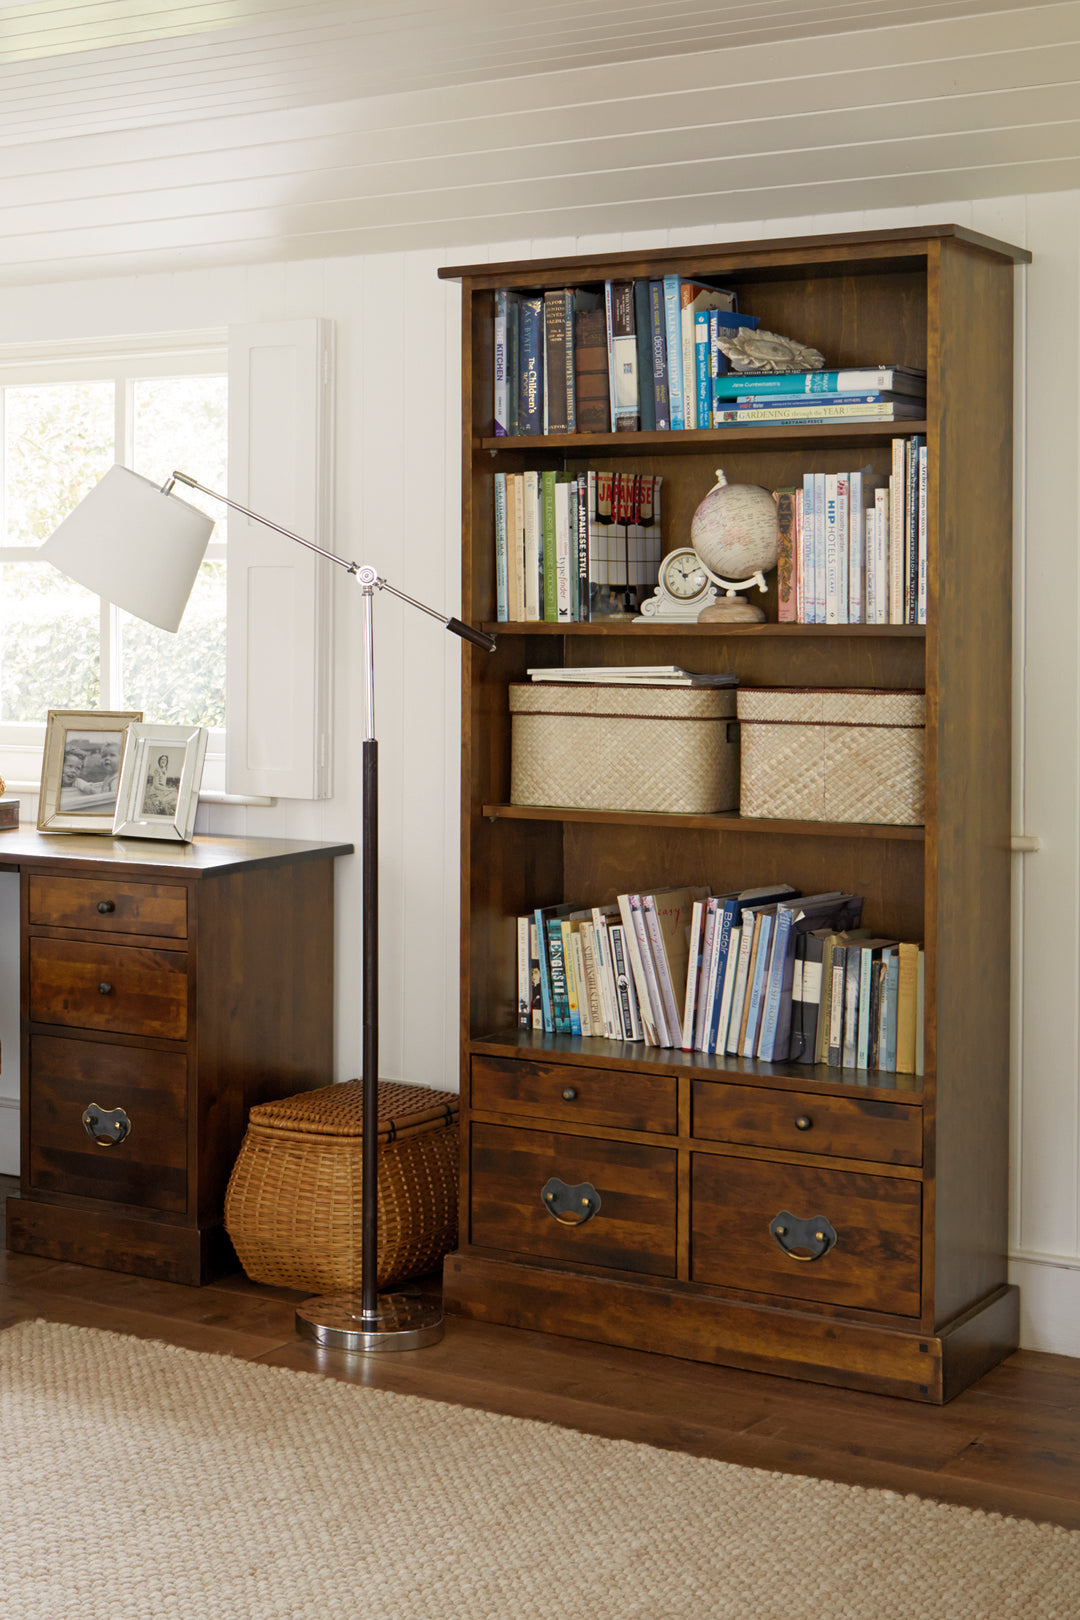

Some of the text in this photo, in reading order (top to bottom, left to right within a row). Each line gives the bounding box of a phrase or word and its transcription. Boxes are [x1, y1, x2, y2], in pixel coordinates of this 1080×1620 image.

[523, 327, 531, 354] BYATT
[653, 336, 666, 378] decorating
[528, 357, 537, 414] The Children's
[739, 410, 791, 420] GARDENING
[823, 405, 845, 416] YEAR
[599, 483, 652, 504] JAPANESE
[610, 503, 642, 524] STYLE
[804, 499, 813, 532] relaxed
[827, 500, 836, 525] HIP
[579, 504, 588, 578] JAPANESE STYLE
[804, 534, 813, 562] home
[827, 526, 836, 565] HOTELS
[657, 908, 682, 935] easy
[720, 911, 733, 954] Boudoir
[740, 934, 752, 955] junk
[770, 960, 783, 1001] SWEDISH
[766, 1004, 778, 1034] ROOM
